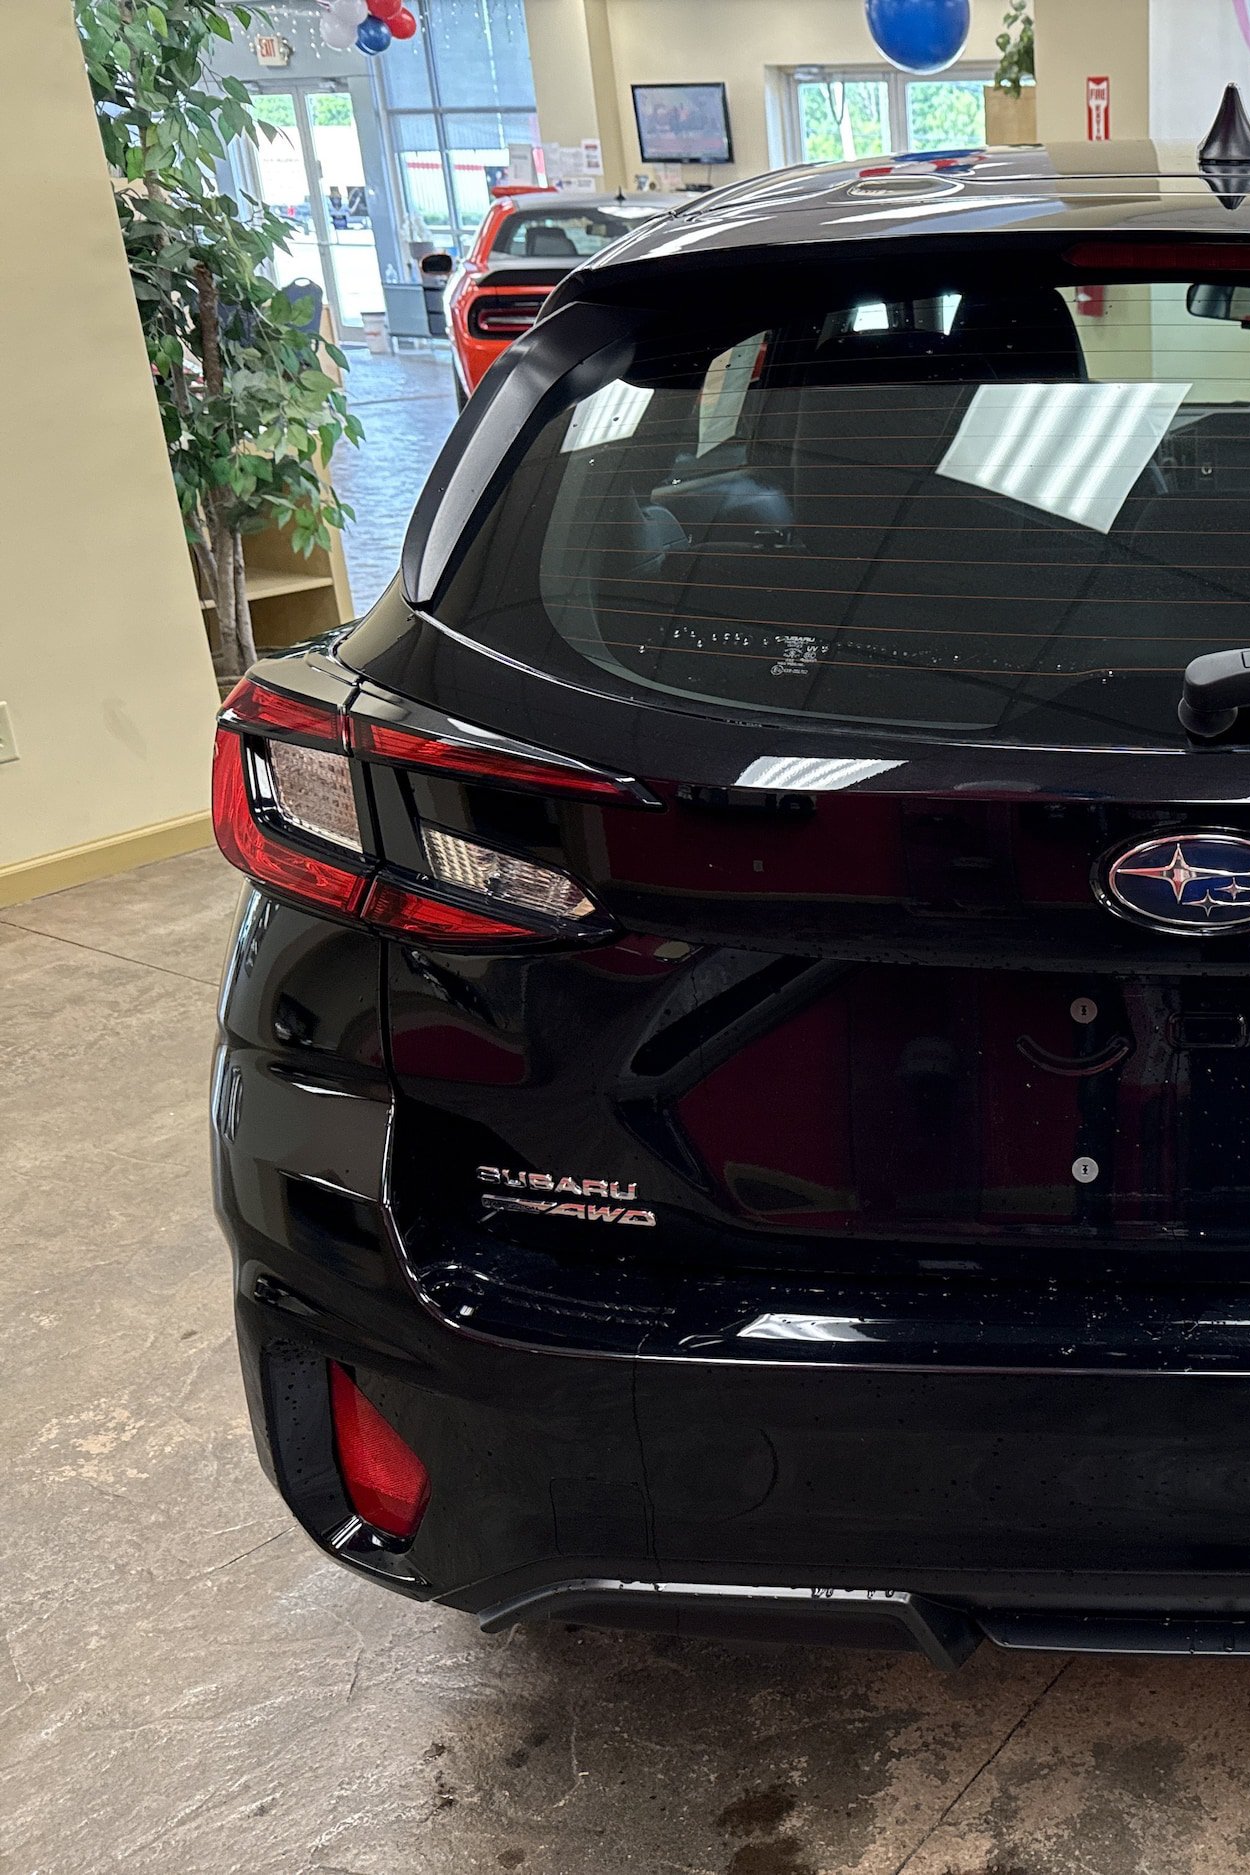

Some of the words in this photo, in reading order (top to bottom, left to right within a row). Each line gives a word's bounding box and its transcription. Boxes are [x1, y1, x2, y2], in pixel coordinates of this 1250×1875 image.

[258, 38, 276, 57] EXIT
[1089, 87, 1106, 101] FIRE
[476, 1165, 638, 1200] SUBARU
[545, 1202, 657, 1228] AWD
